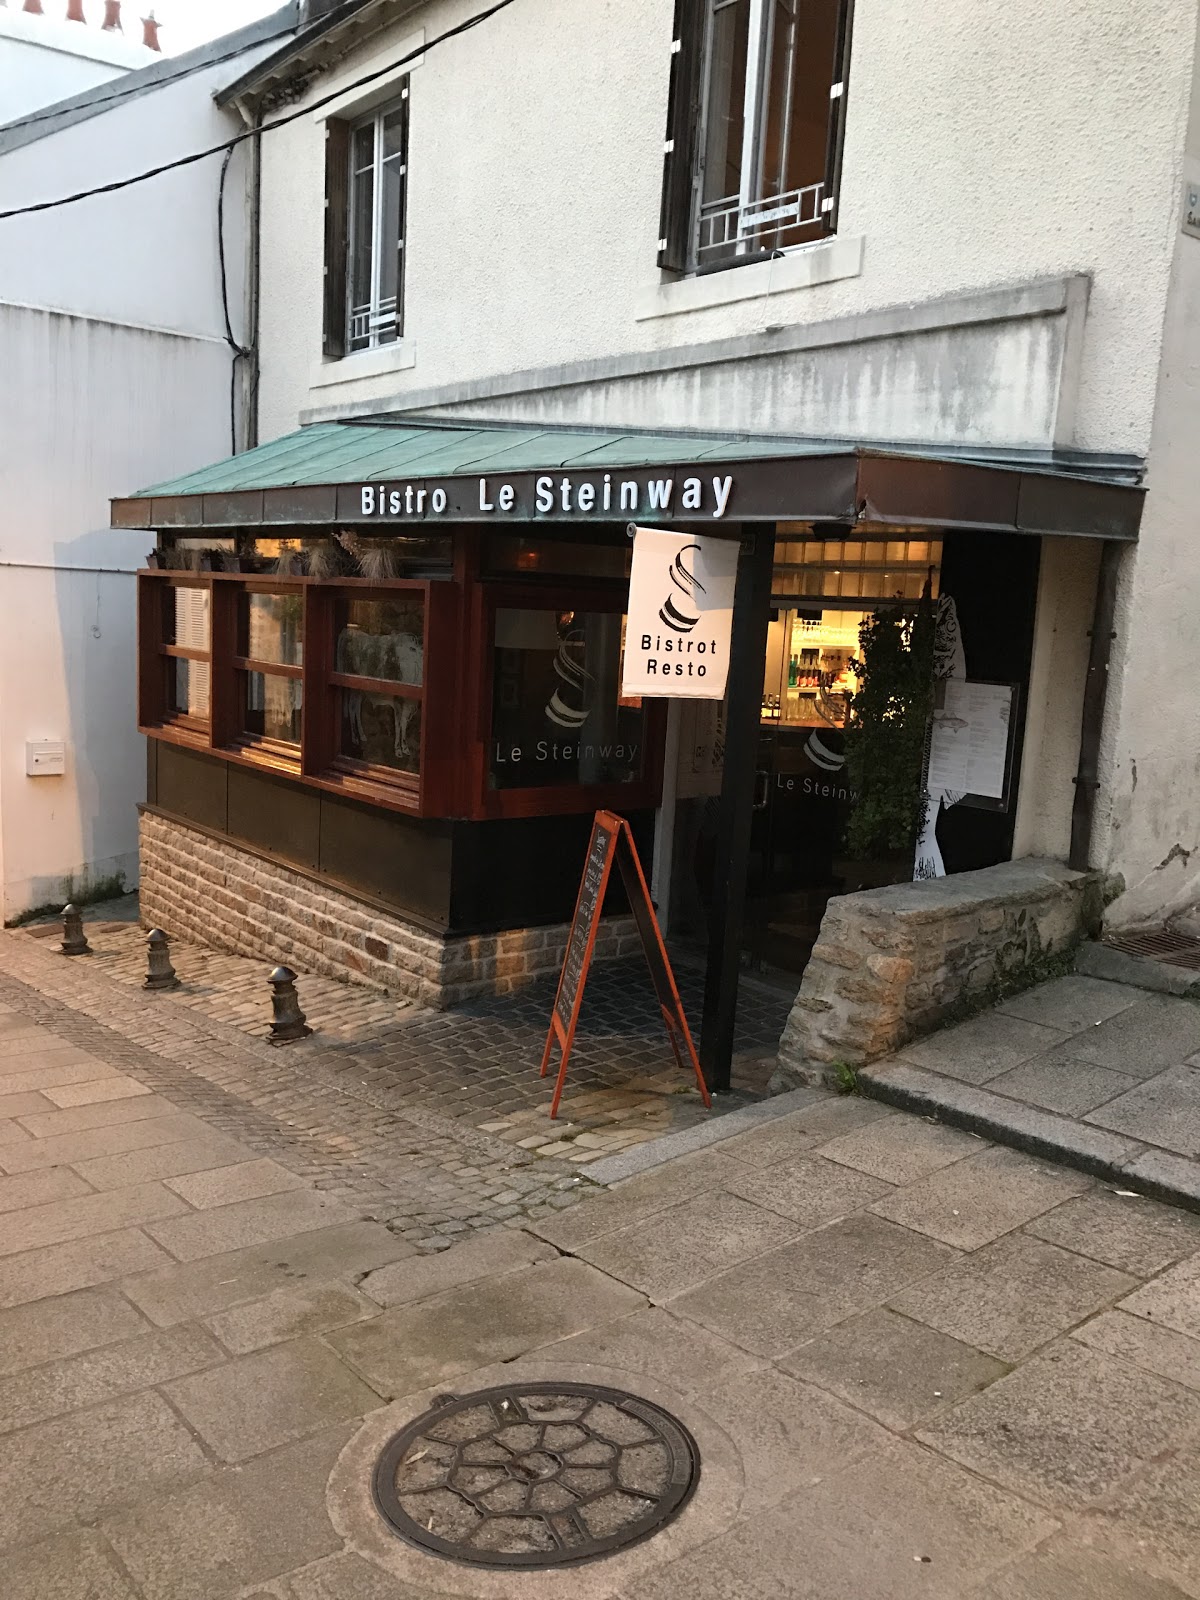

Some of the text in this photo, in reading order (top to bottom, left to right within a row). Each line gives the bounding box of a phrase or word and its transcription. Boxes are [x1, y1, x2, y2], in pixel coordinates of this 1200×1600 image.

[361, 474, 733, 518] Bistro Le Steinway
[641, 634, 717, 655] Bistrot
[646, 659, 706, 677] Resto
[496, 741, 638, 763] Le Steinway
[777, 773, 794, 790] Le
